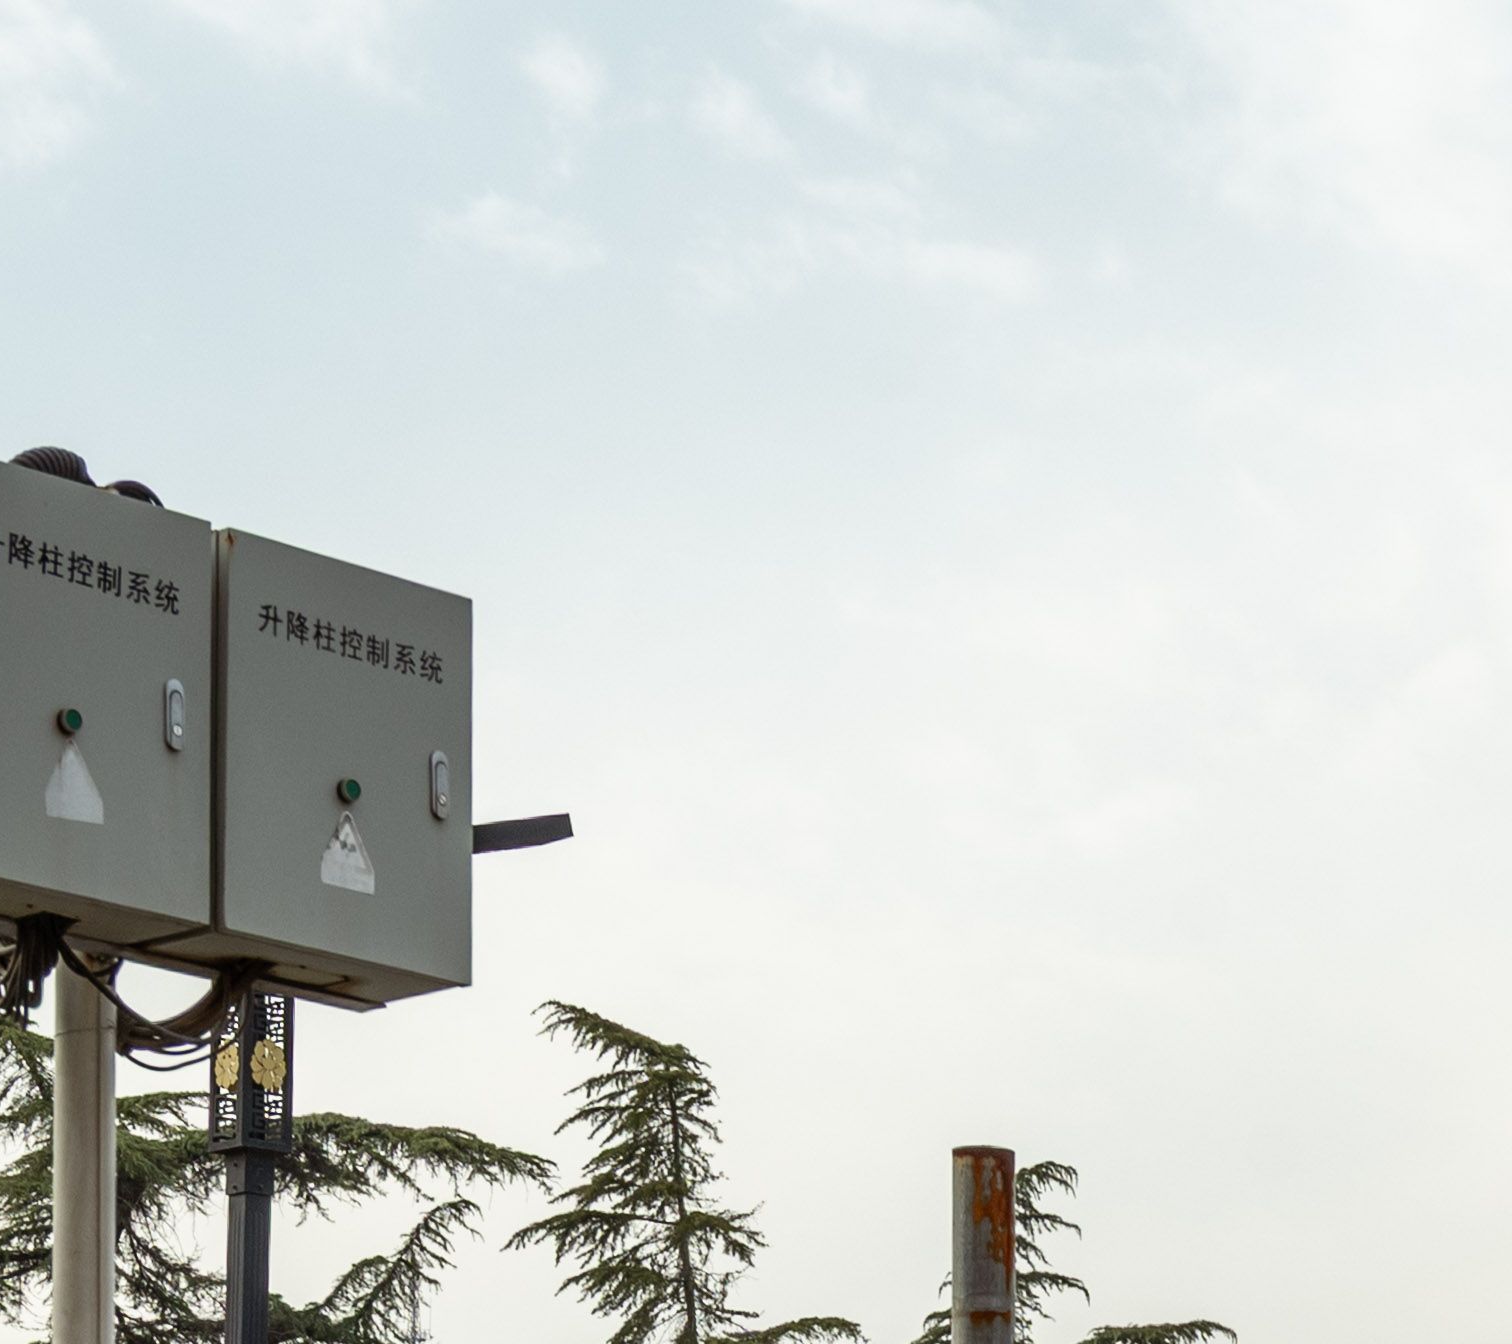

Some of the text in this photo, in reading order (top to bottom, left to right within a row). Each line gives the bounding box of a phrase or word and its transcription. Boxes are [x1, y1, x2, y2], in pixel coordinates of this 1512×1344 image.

[257, 602, 444, 685] 升降柱控制系统
